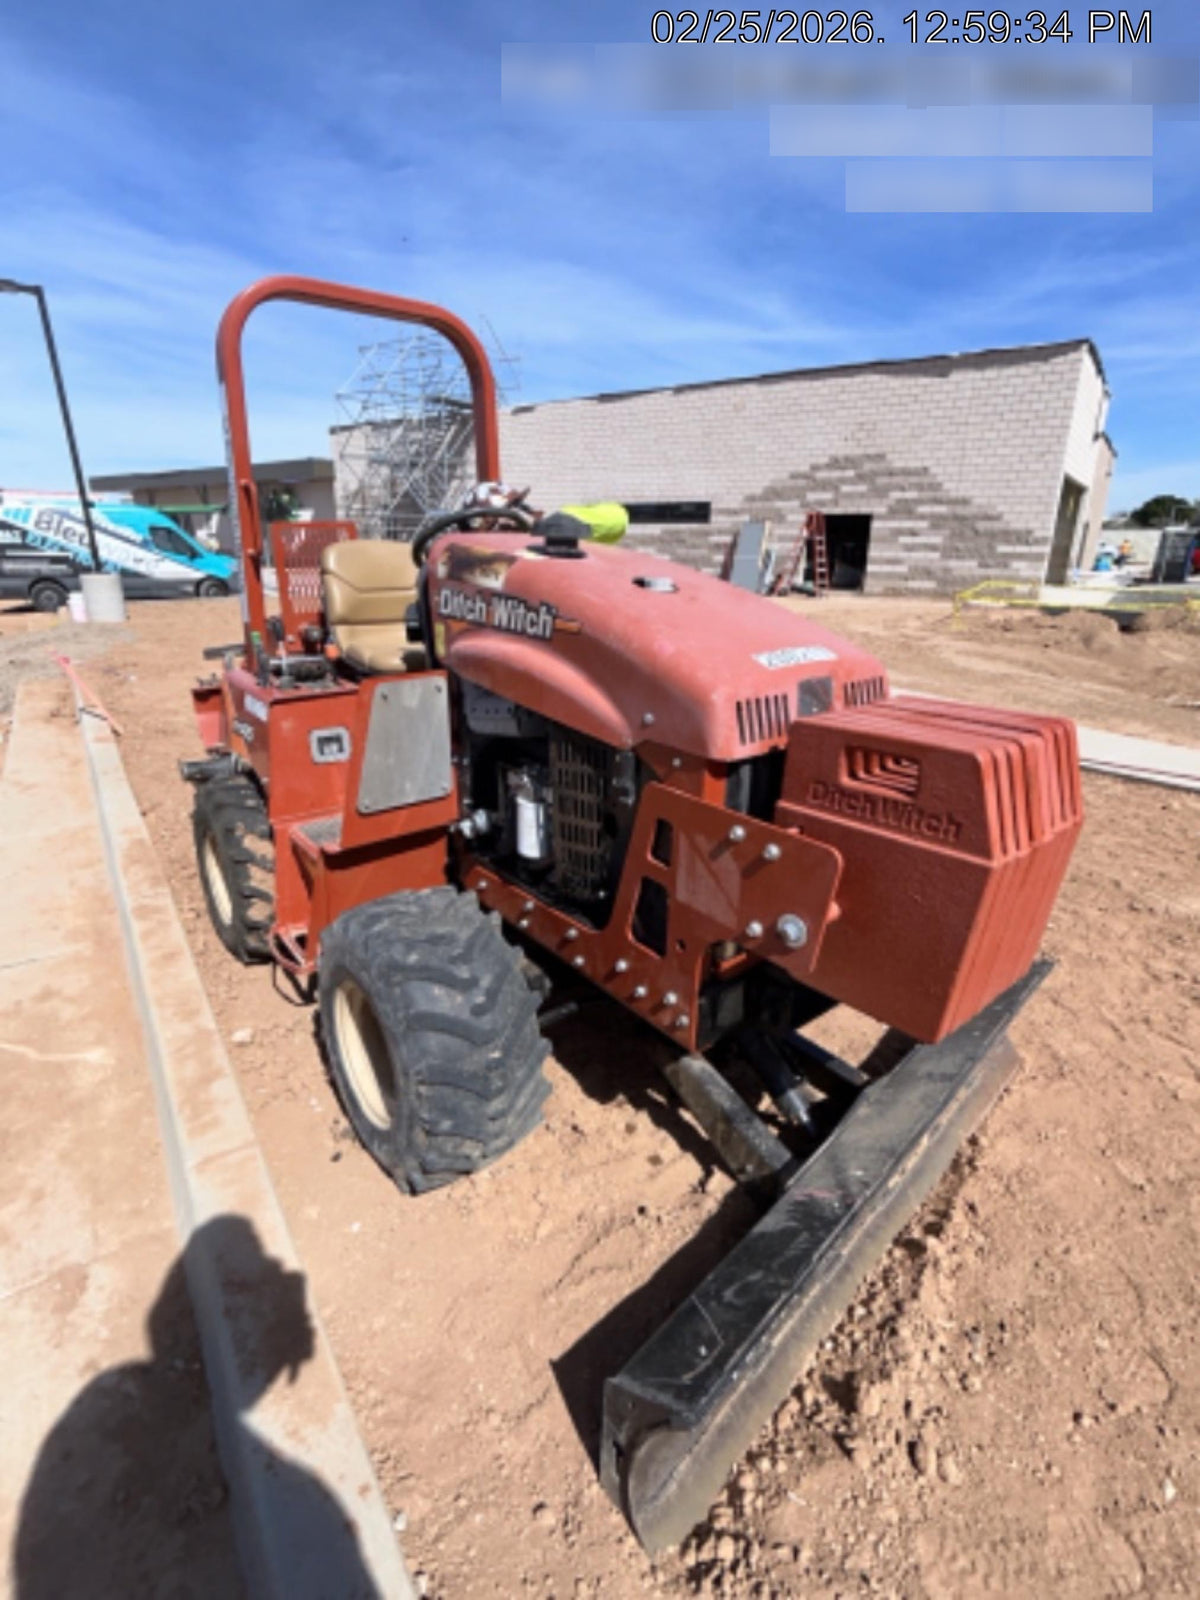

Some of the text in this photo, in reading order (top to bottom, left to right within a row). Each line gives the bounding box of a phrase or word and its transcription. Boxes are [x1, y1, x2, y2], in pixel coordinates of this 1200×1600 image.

[439, 588, 553, 640] Ditch Witch
[807, 781, 962, 842] Ditch Witch
